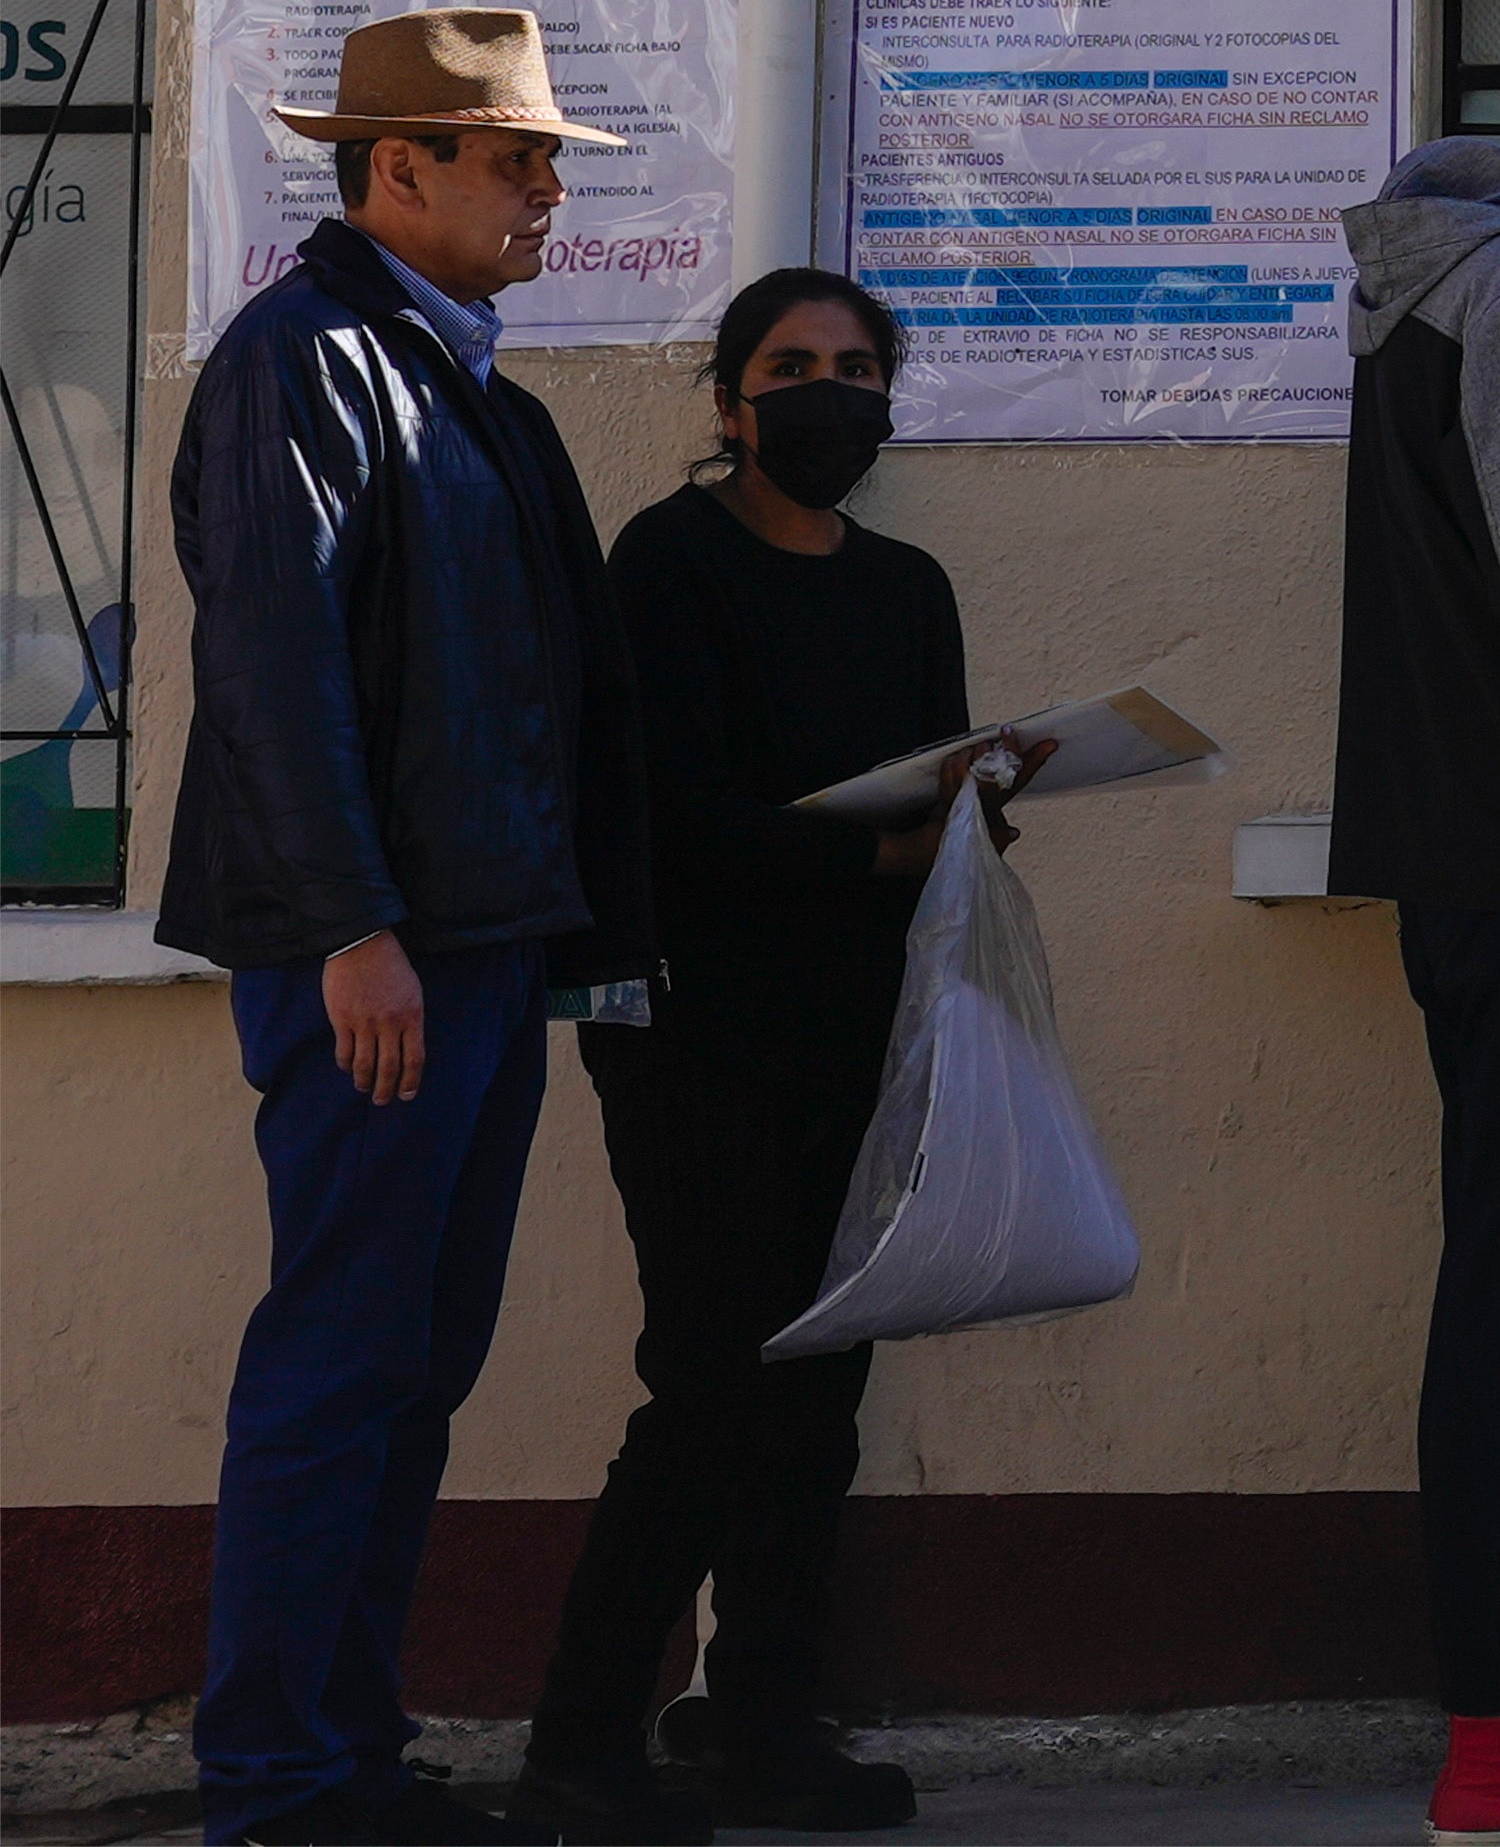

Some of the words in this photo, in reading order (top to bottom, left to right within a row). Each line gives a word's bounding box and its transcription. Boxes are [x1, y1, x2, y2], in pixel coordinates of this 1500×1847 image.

[285, 6, 370, 17] RADIOTERAPIA
[574, 43, 611, 54] SACAR
[615, 43, 648, 53] FICHA
[563, 105, 647, 117] RADIOTERAPIA
[617, 123, 631, 134] LA
[634, 123, 680, 134] IGLESIA)
[573, 146, 614, 157] TURNO
[618, 146, 632, 156] EN
[637, 145, 648, 155] EL
[578, 186, 637, 197] ATENDIDO
[640, 185, 654, 196] AL
[282, 193, 338, 203] PACIENTE
[546, 228, 700, 282] oterapia
[1180, 327, 1338, 340] RESPONSABILIZARA
[1101, 389, 1156, 403] TOMAR
[1162, 388, 1232, 402] DEBIDAS
